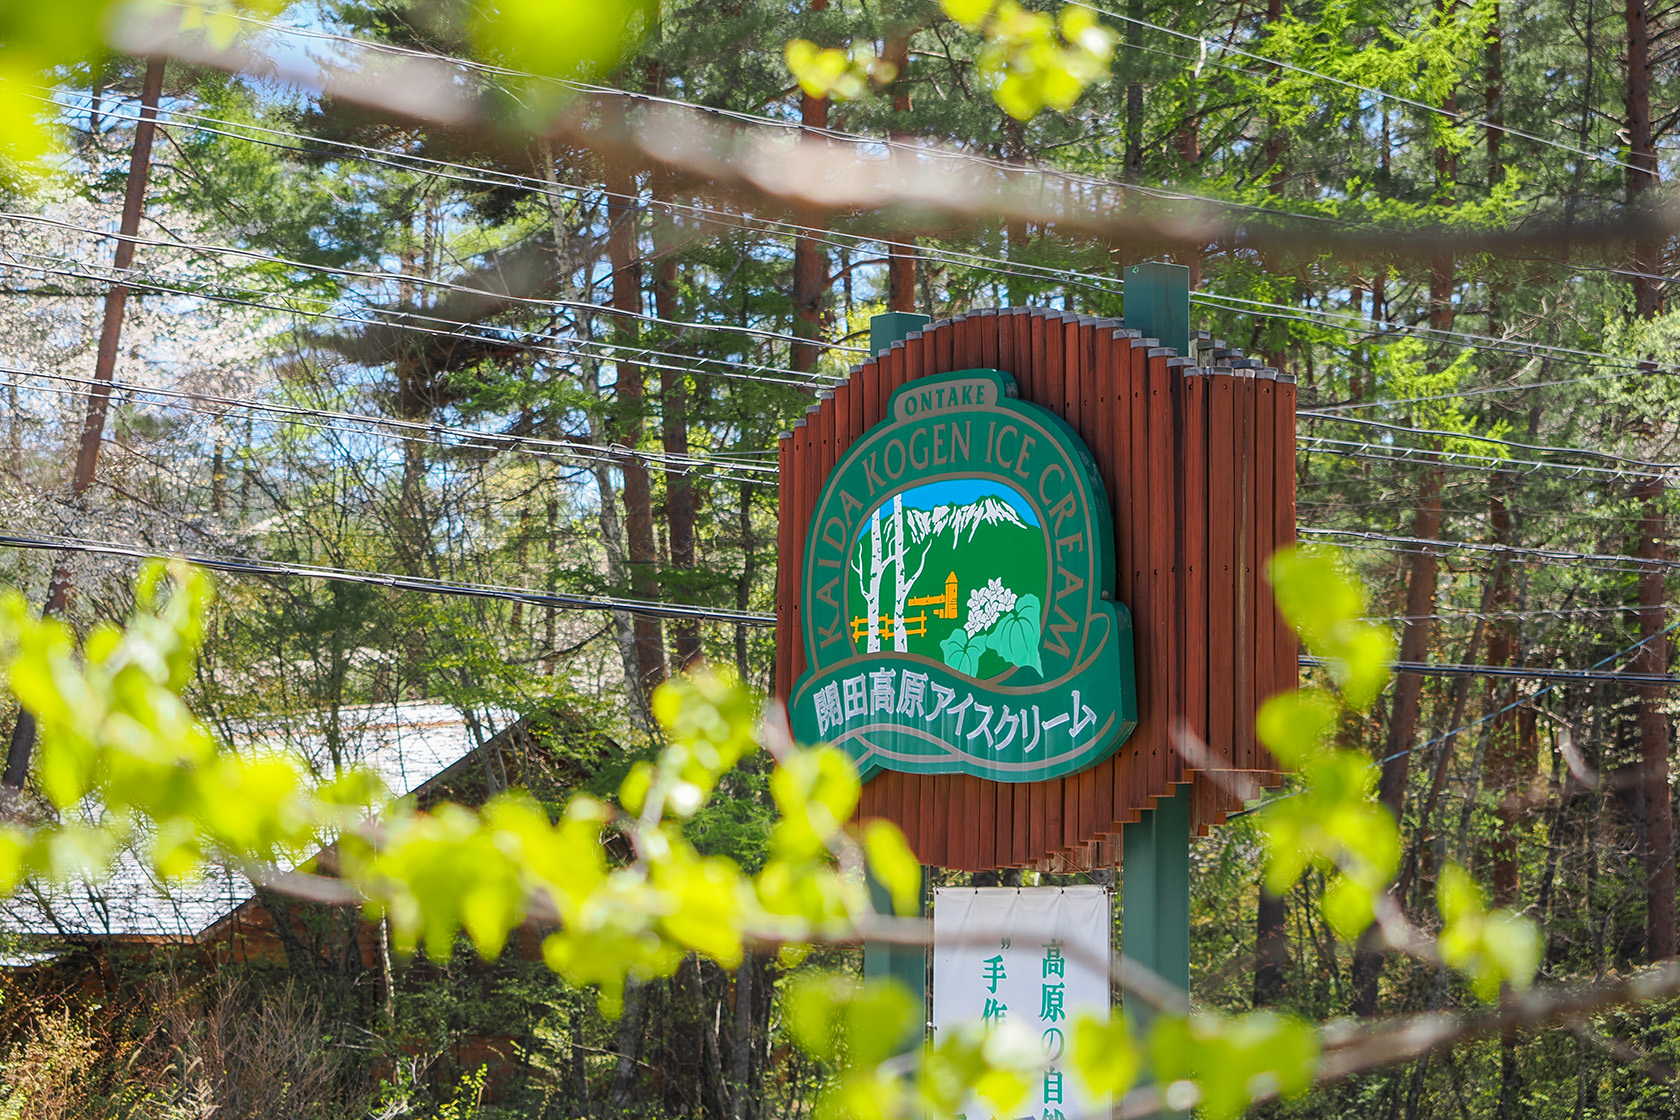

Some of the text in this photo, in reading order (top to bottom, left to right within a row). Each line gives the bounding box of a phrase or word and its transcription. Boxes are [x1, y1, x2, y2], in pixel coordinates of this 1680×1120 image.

[903, 383, 987, 416] ONTAKE
[817, 420, 1085, 661] KAIDA KOGEN ICE CREAM
[813, 667, 1097, 753] 開田高原アイスクリーム
